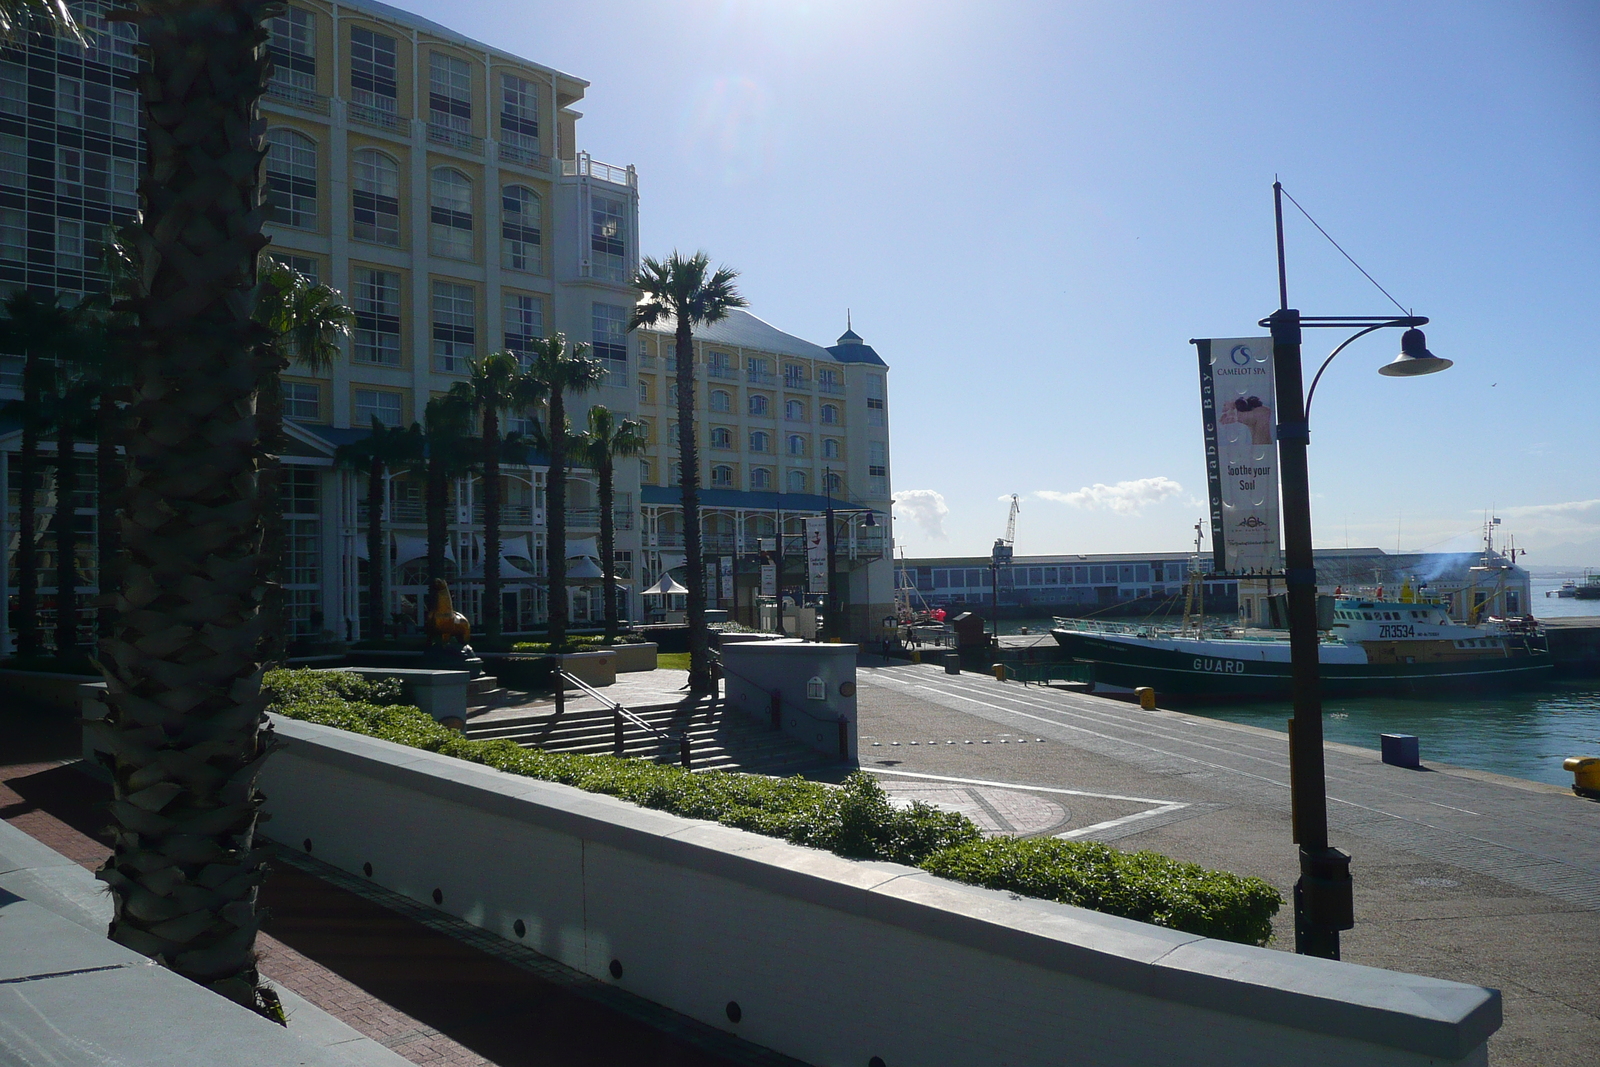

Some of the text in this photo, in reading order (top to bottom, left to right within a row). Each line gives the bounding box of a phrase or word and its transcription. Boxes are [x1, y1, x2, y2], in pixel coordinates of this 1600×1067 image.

[1217, 367, 1266, 376] CAMELOT SPA
[1203, 373, 1222, 536] The Table Bay
[1253, 468, 1270, 478] your
[1379, 625, 1415, 638] ZR3534
[1193, 658, 1245, 673] GUARD
